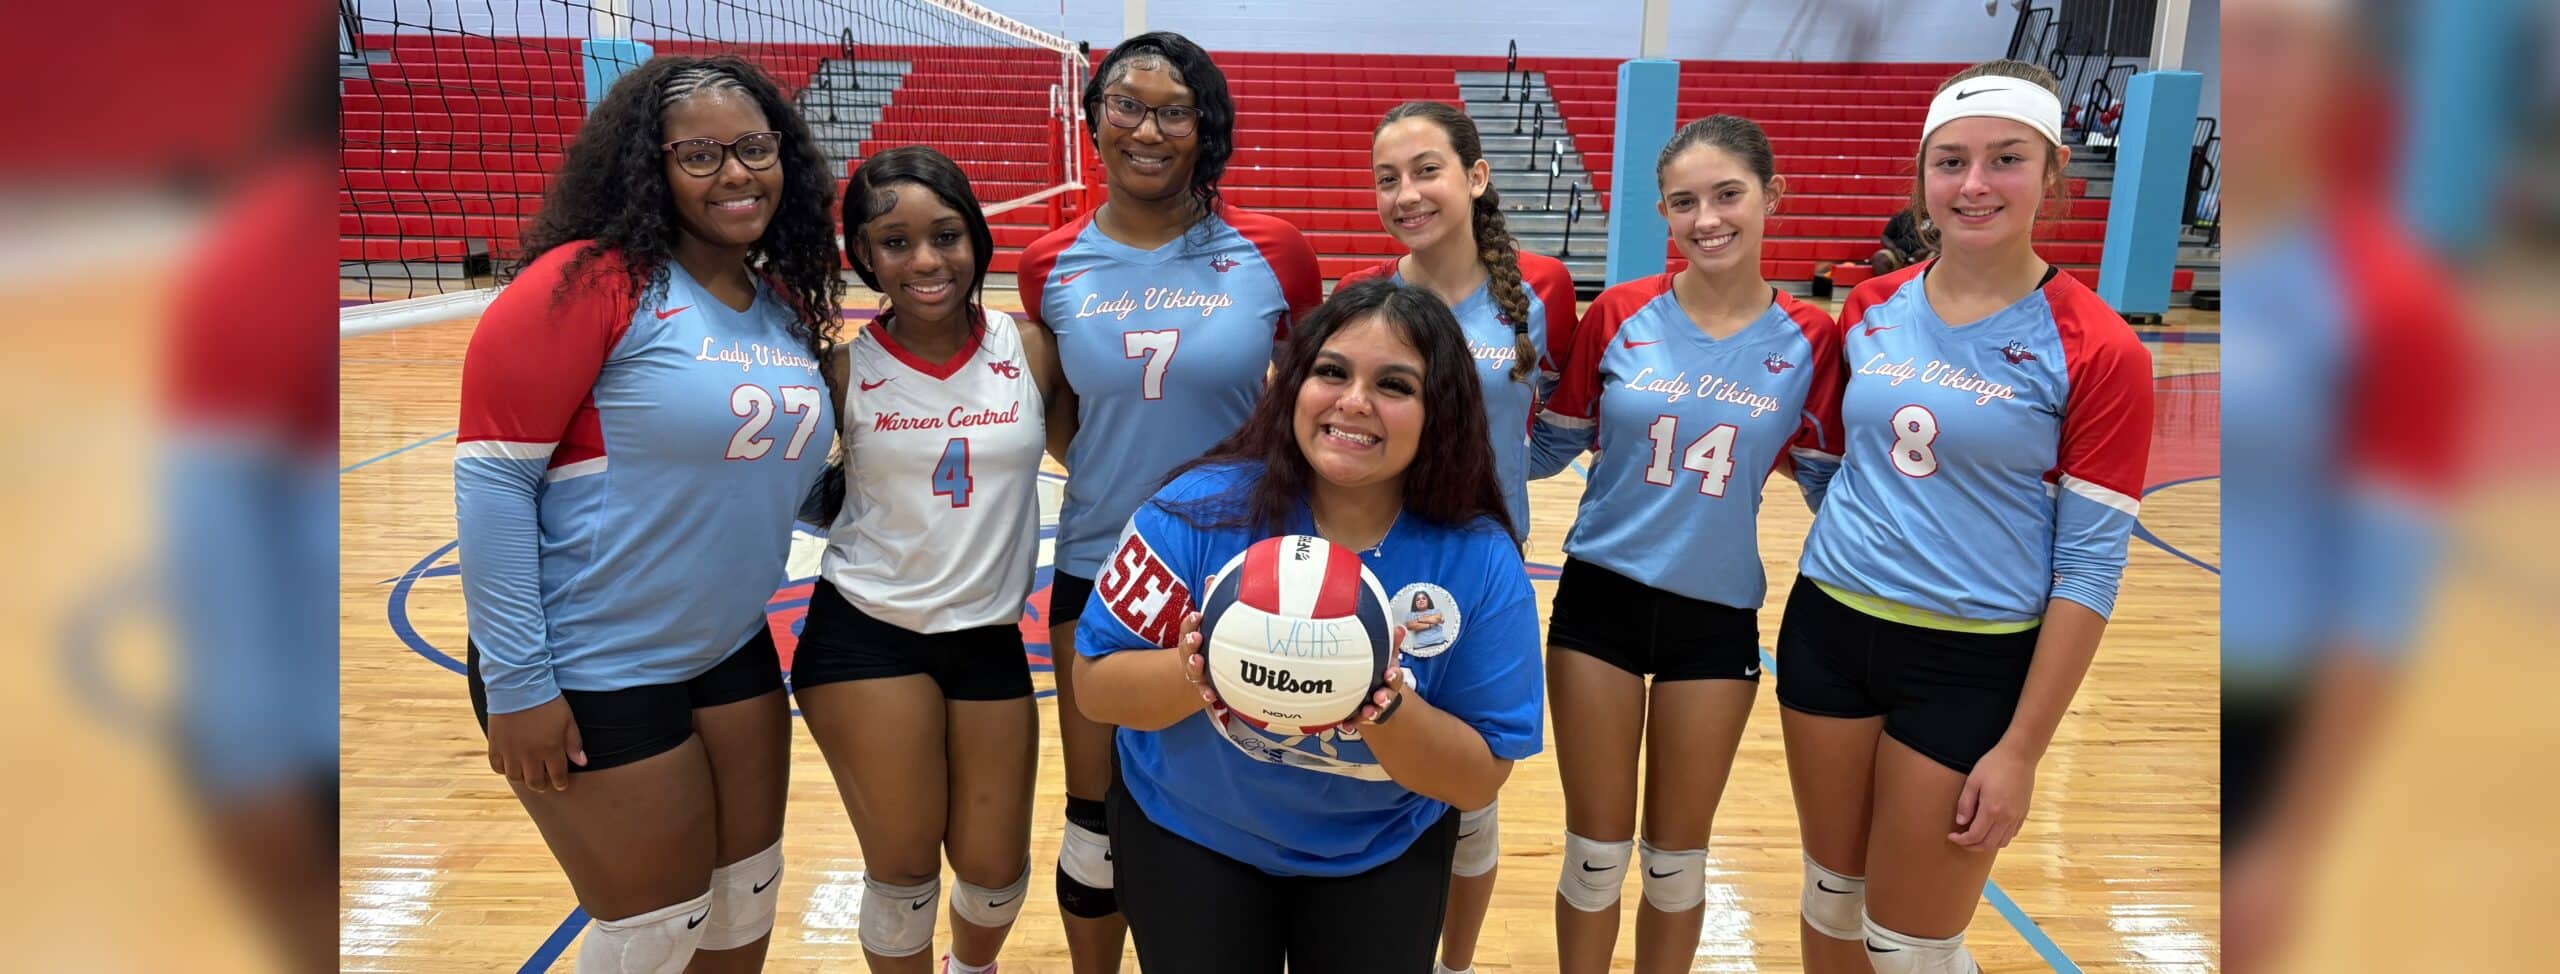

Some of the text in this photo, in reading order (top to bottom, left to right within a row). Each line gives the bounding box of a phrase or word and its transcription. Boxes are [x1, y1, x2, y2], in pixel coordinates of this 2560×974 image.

[1075, 287, 1233, 320] Lady Vikings
[696, 336, 753, 373] Lady
[1123, 328, 1180, 400] 7
[1857, 352, 2017, 406] Lady Vikings
[873, 400, 1020, 433] Warren Central
[1624, 367, 1780, 417] Lady Vikings
[724, 383, 822, 460] 27
[1888, 403, 1941, 479] 8
[931, 436, 974, 509] 4
[1644, 414, 1738, 498] 14
[1265, 614, 1342, 659] WCHS
[1240, 659, 1334, 694] Wilson
[1262, 708, 1302, 719] NOVA
